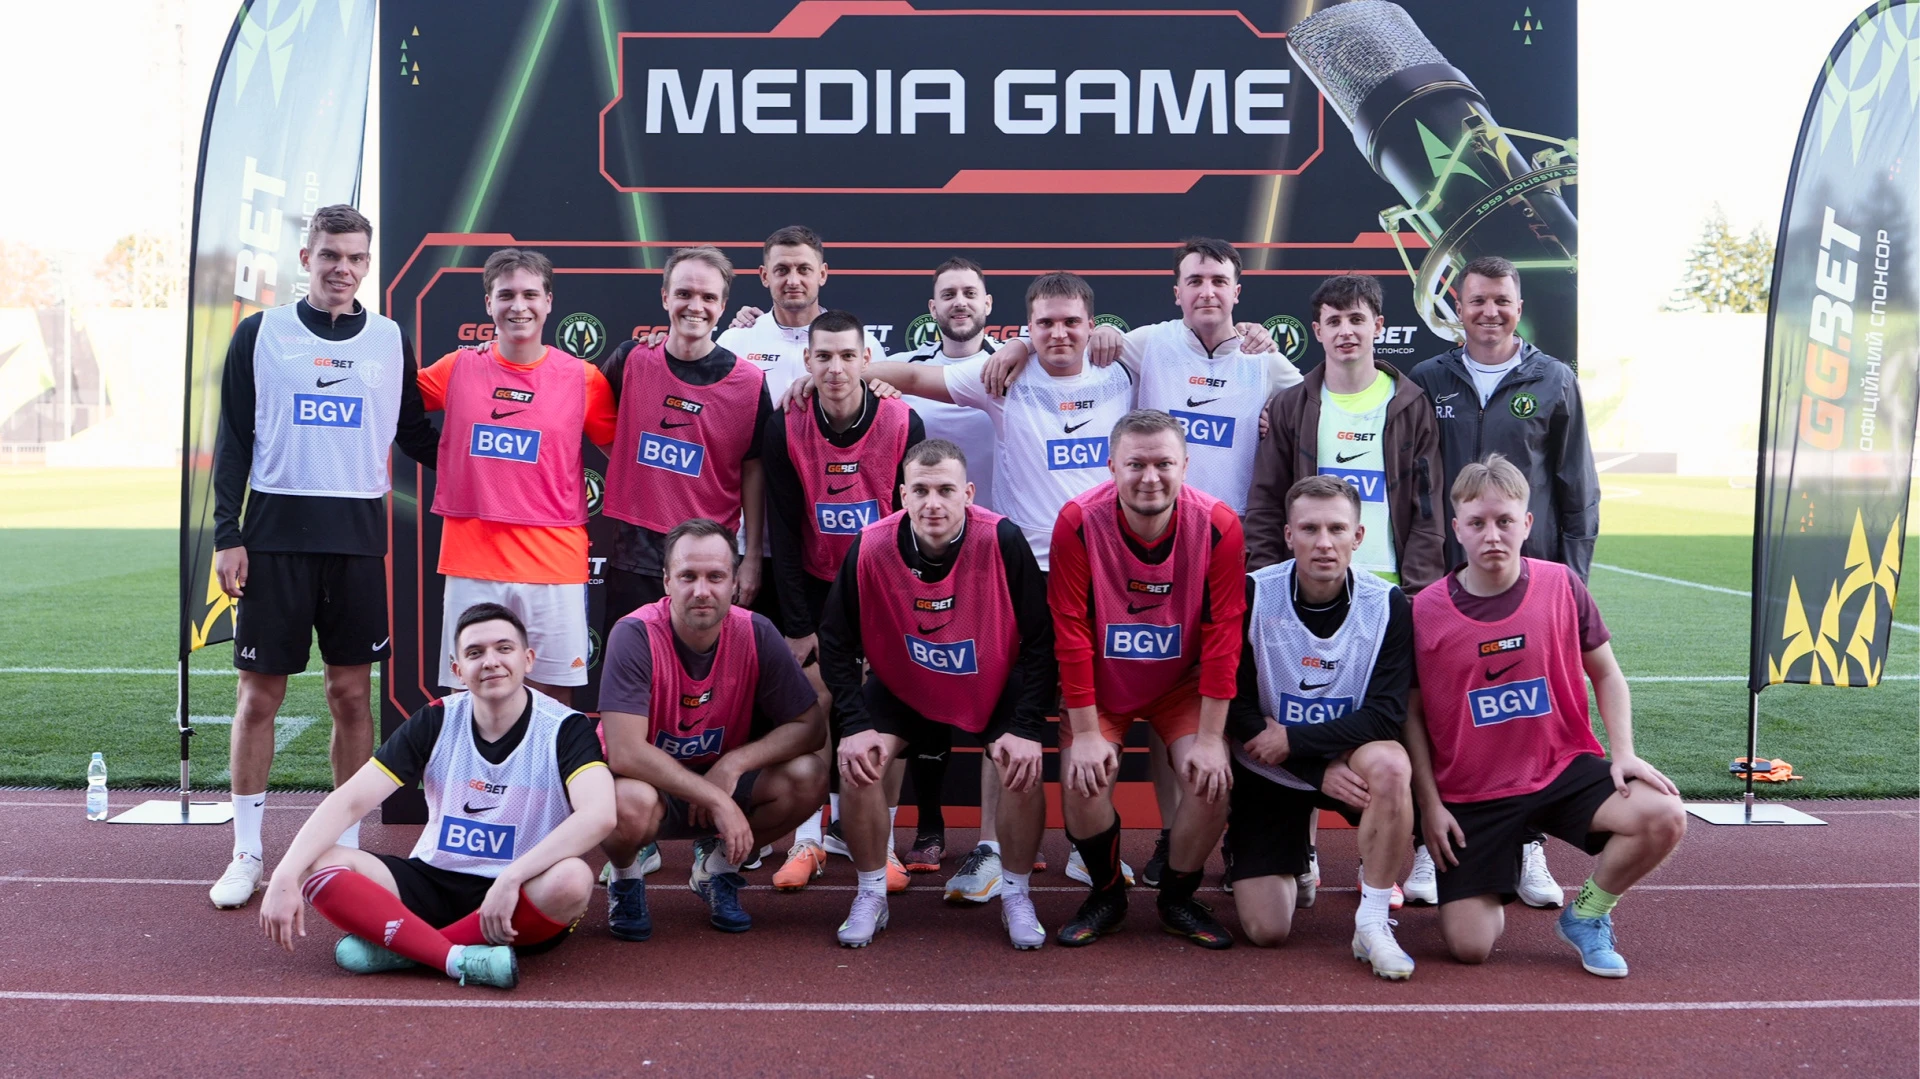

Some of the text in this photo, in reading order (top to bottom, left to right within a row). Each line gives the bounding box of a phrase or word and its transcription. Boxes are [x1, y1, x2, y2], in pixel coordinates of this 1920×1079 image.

[645, 69, 1291, 134] MEDIA GAME
[1475, 194, 1503, 216] 1959
[1505, 171, 1562, 196] POLISSYA
[1870, 229, 1891, 327] СПОНСОР
[1799, 205, 1862, 451] GG.BET
[1377, 347, 1415, 355] СПОНСОР
[299, 399, 357, 423] BGV
[477, 430, 533, 456] BGV
[643, 439, 697, 469] BGV
[1053, 442, 1103, 466] BGV
[821, 507, 871, 529] BGV
[241, 646, 257, 660] 44
[912, 641, 966, 669] BGV
[1113, 630, 1174, 654] BGV
[1286, 700, 1346, 724] BGV
[1477, 686, 1538, 719] BGV
[661, 734, 716, 756] BGV
[446, 823, 507, 853] BGV
